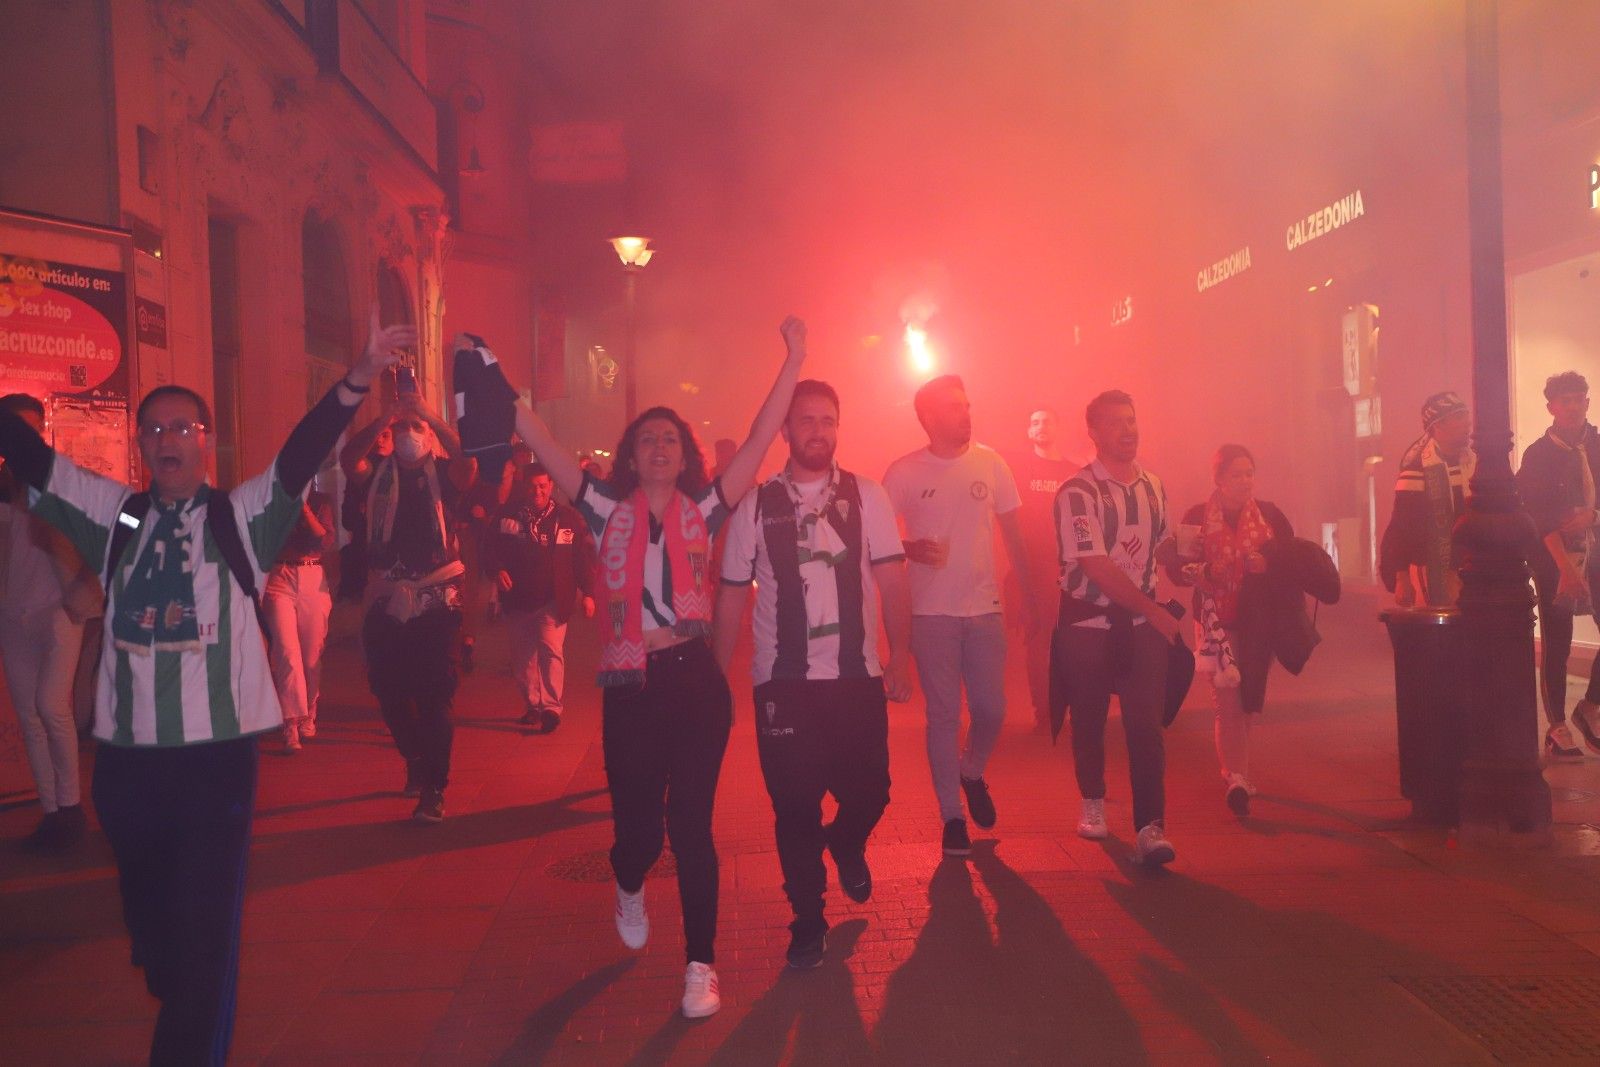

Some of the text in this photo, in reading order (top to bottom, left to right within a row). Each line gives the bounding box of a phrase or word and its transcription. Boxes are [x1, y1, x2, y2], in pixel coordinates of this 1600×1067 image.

[1286, 189, 1364, 251] CALZEDONIA
[39, 269, 90, 289] artículos
[93, 278, 111, 292] en:
[1197, 246, 1251, 293] CALZEDONIA
[43, 301, 72, 321] shop
